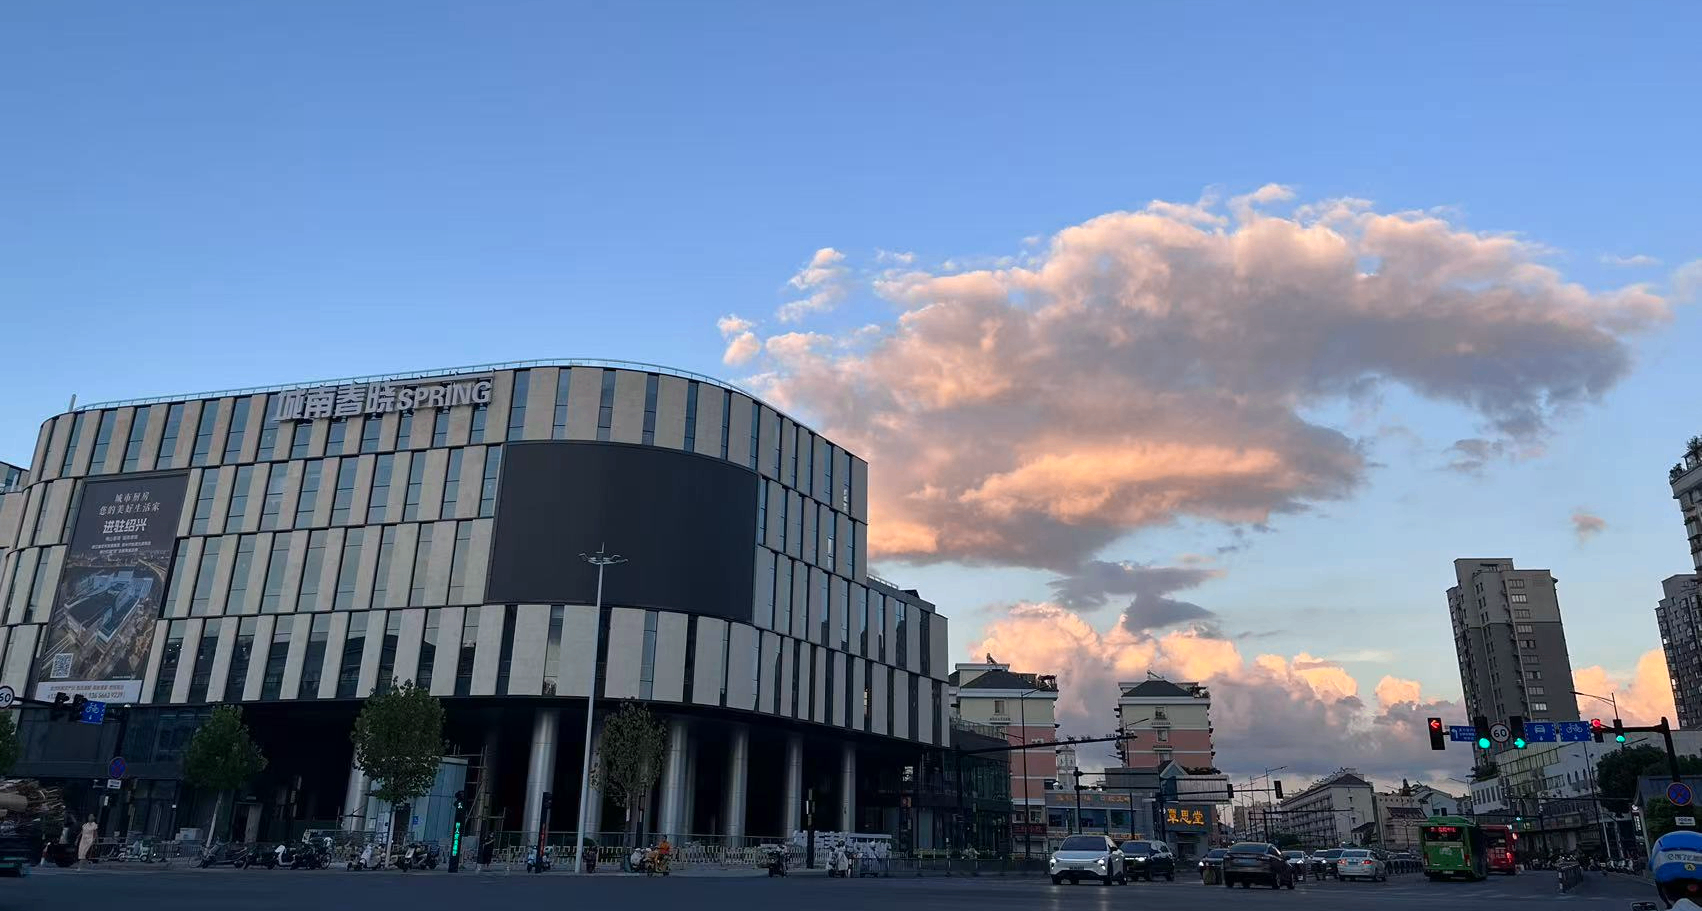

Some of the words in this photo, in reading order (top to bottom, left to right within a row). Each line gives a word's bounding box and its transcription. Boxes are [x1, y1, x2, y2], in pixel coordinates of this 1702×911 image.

[276, 381, 397, 421] 城南春晓
[397, 381, 491, 411] SPRING
[103, 518, 147, 534] 进驻绍兴
[1493, 728, 1508, 738] 60
